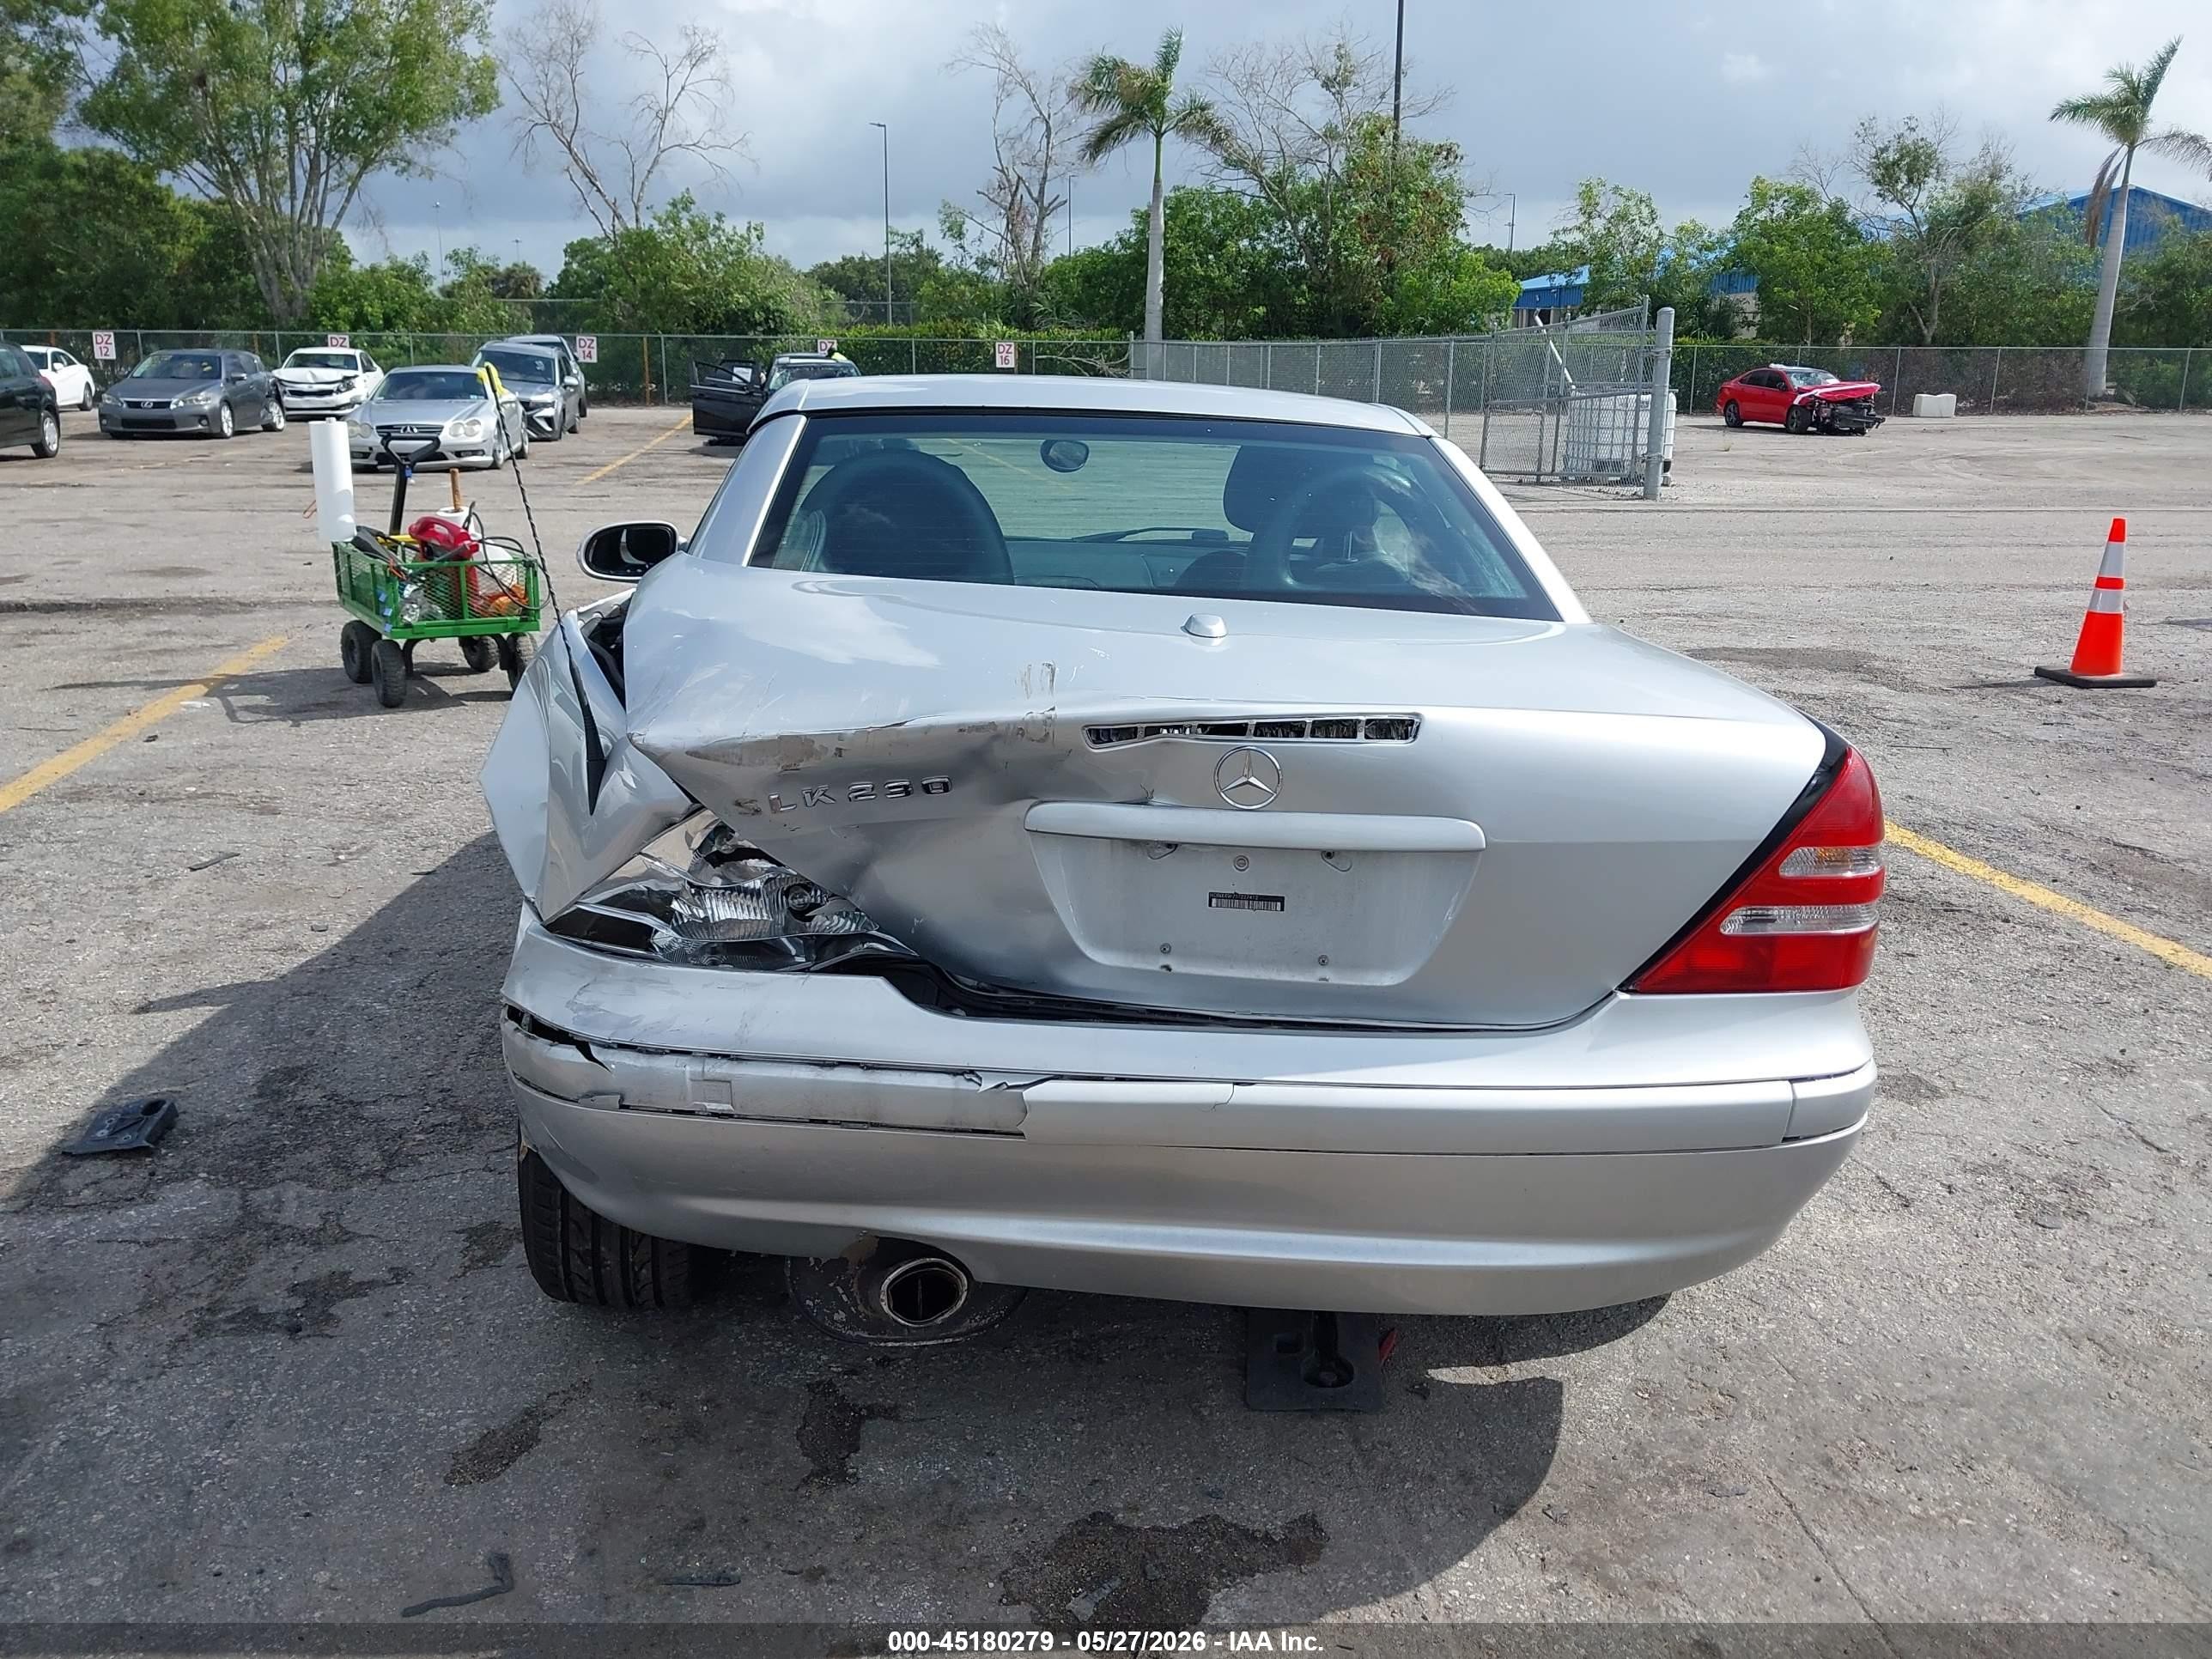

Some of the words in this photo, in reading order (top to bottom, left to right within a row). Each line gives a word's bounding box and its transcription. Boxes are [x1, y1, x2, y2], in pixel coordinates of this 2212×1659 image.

[95, 334, 112, 344] DZ
[330, 336, 348, 347] DZ
[578, 338, 595, 349] DZ
[100, 346, 110, 357] 12
[998, 343, 1012, 354] DZ
[583, 350, 592, 360] 14
[1000, 356, 1010, 365] 16
[847, 775, 952, 802] 230
